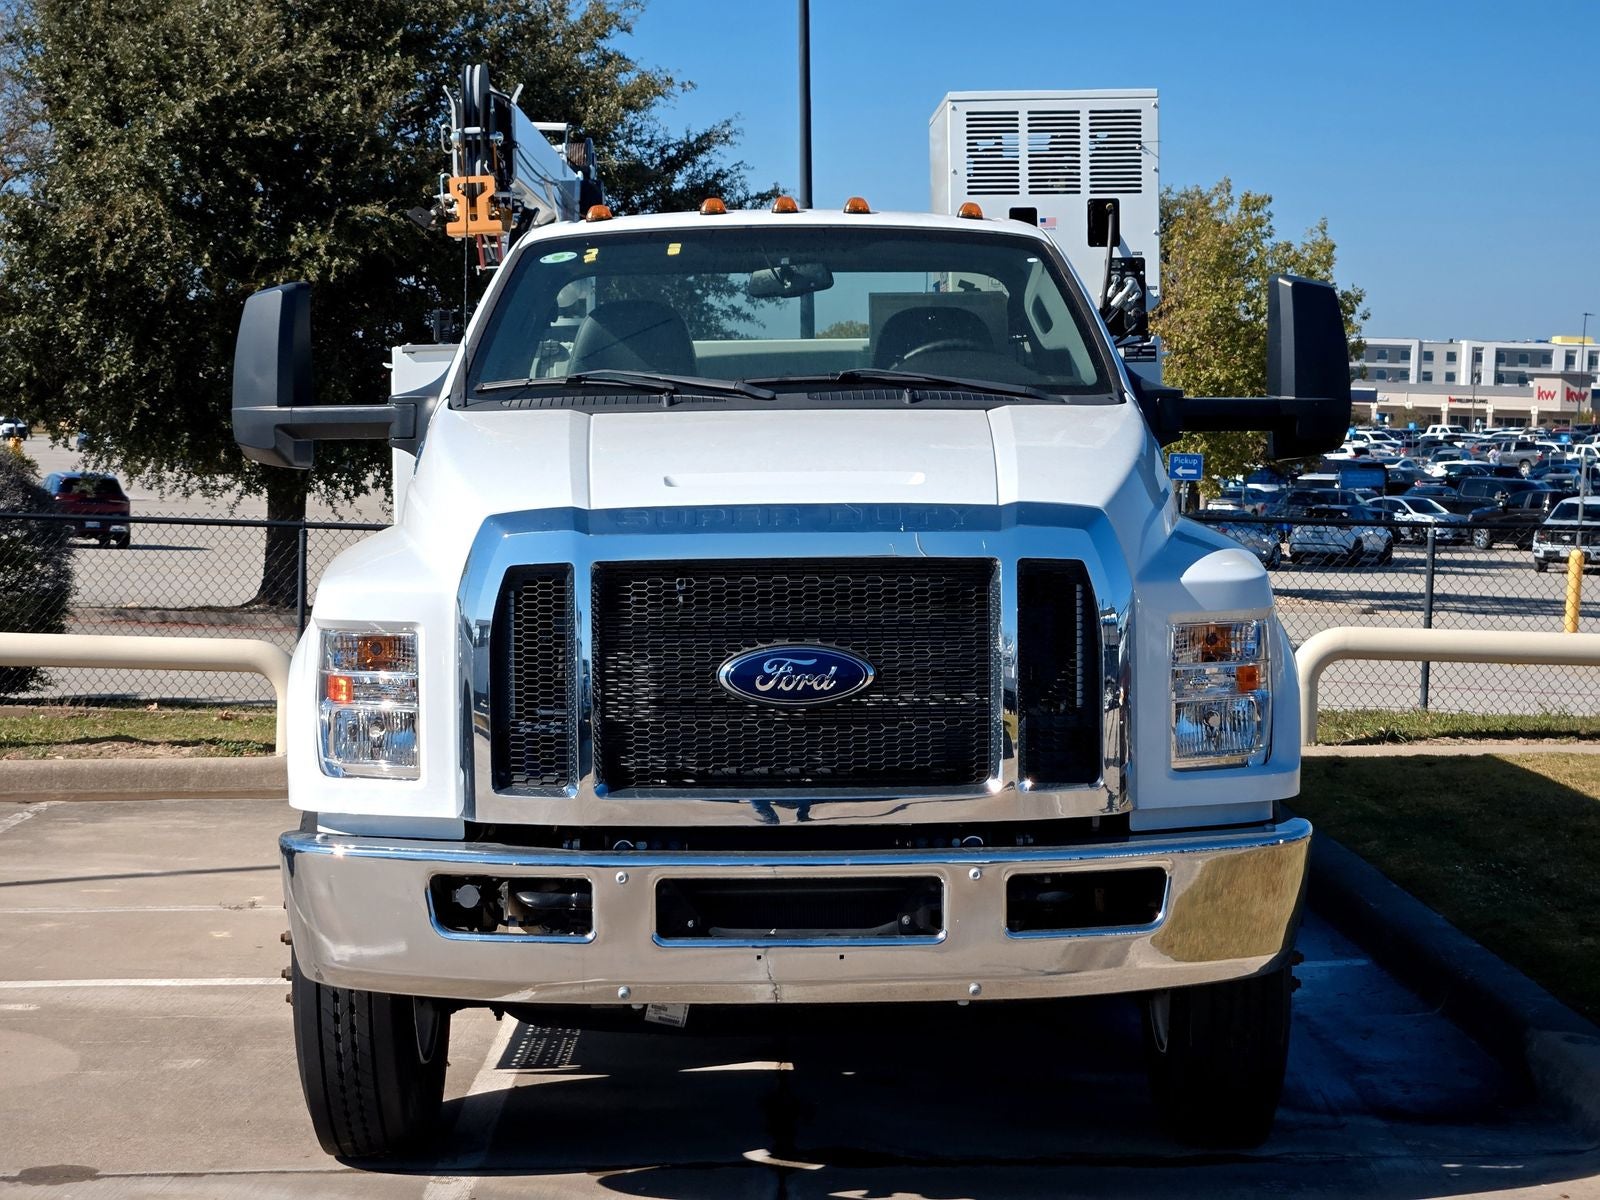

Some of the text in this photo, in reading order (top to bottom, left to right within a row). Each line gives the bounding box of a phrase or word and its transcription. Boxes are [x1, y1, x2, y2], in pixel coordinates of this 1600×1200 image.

[1537, 385, 1557, 401] kw
[1173, 456, 1198, 466] Pickup
[614, 504, 974, 528] SUPER DUTY
[755, 657, 838, 692] Ford
